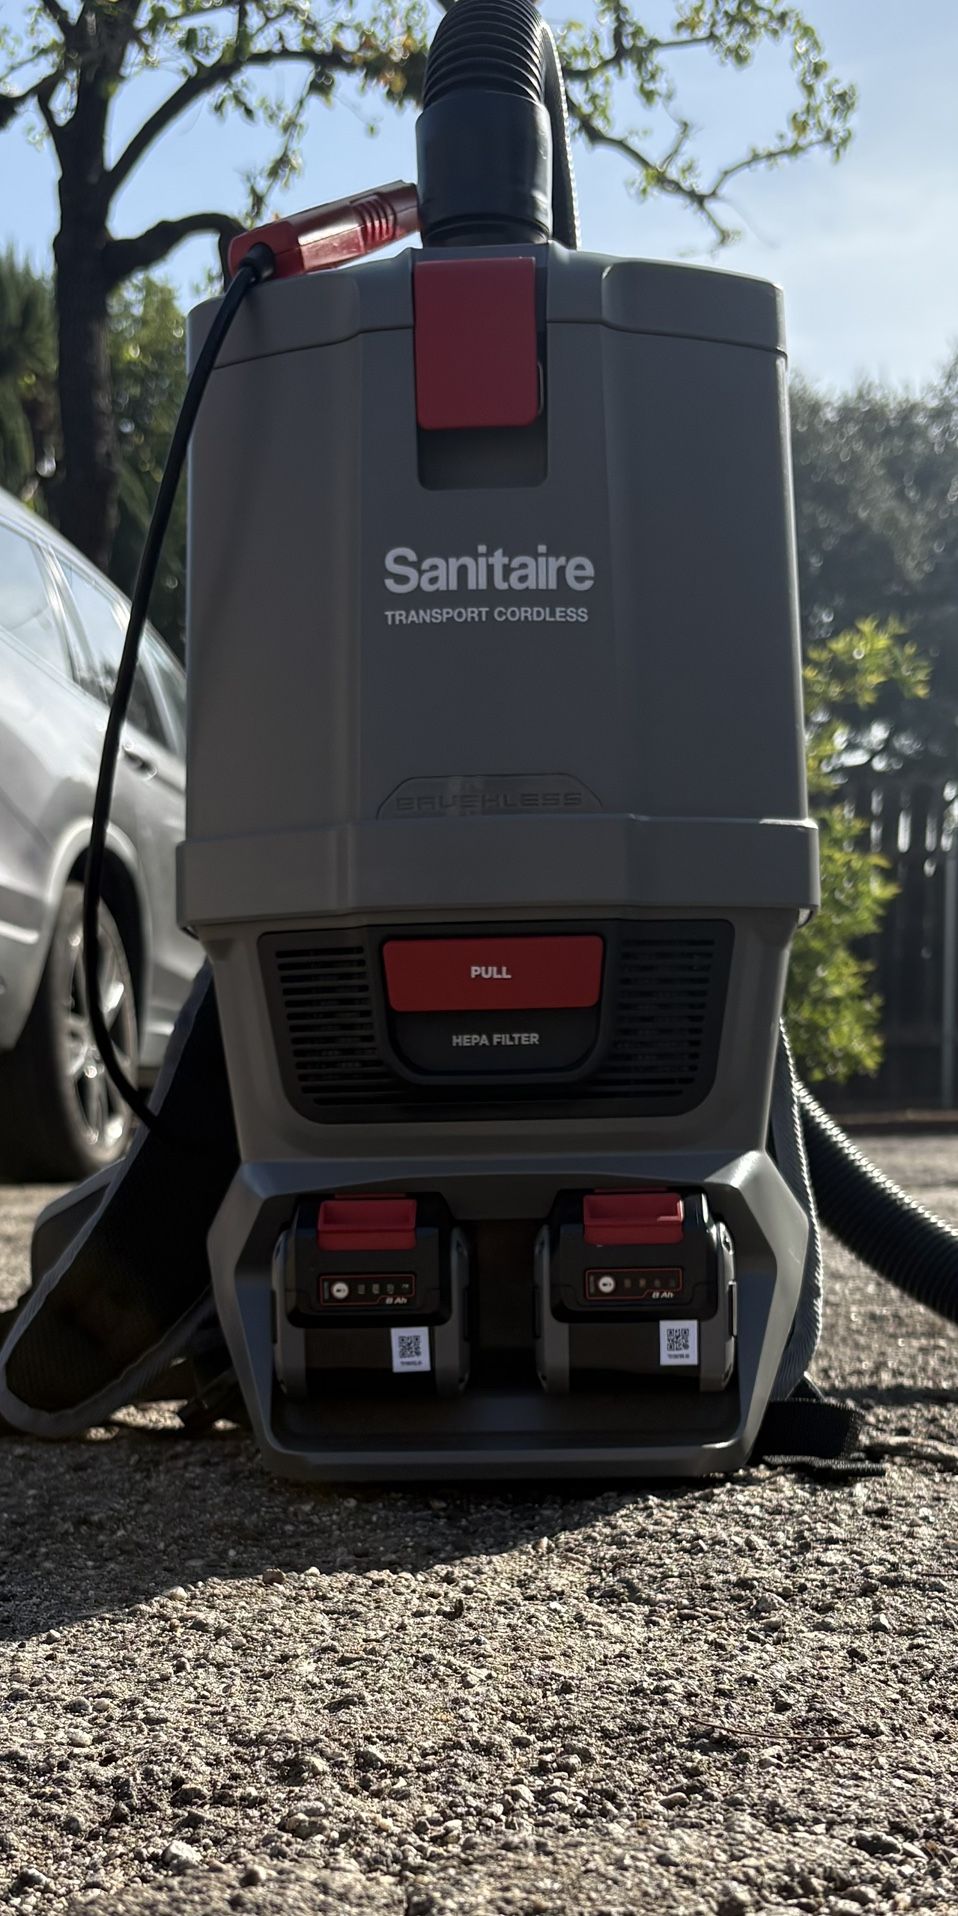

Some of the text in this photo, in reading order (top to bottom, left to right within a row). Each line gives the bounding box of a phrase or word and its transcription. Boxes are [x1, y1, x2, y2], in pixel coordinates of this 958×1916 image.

[384, 545, 595, 594] Sanitaire
[384, 607, 589, 625] TRANSPORT CORDLESS
[470, 966, 512, 979] PULL
[452, 1033, 539, 1046] HEPA FILTER
